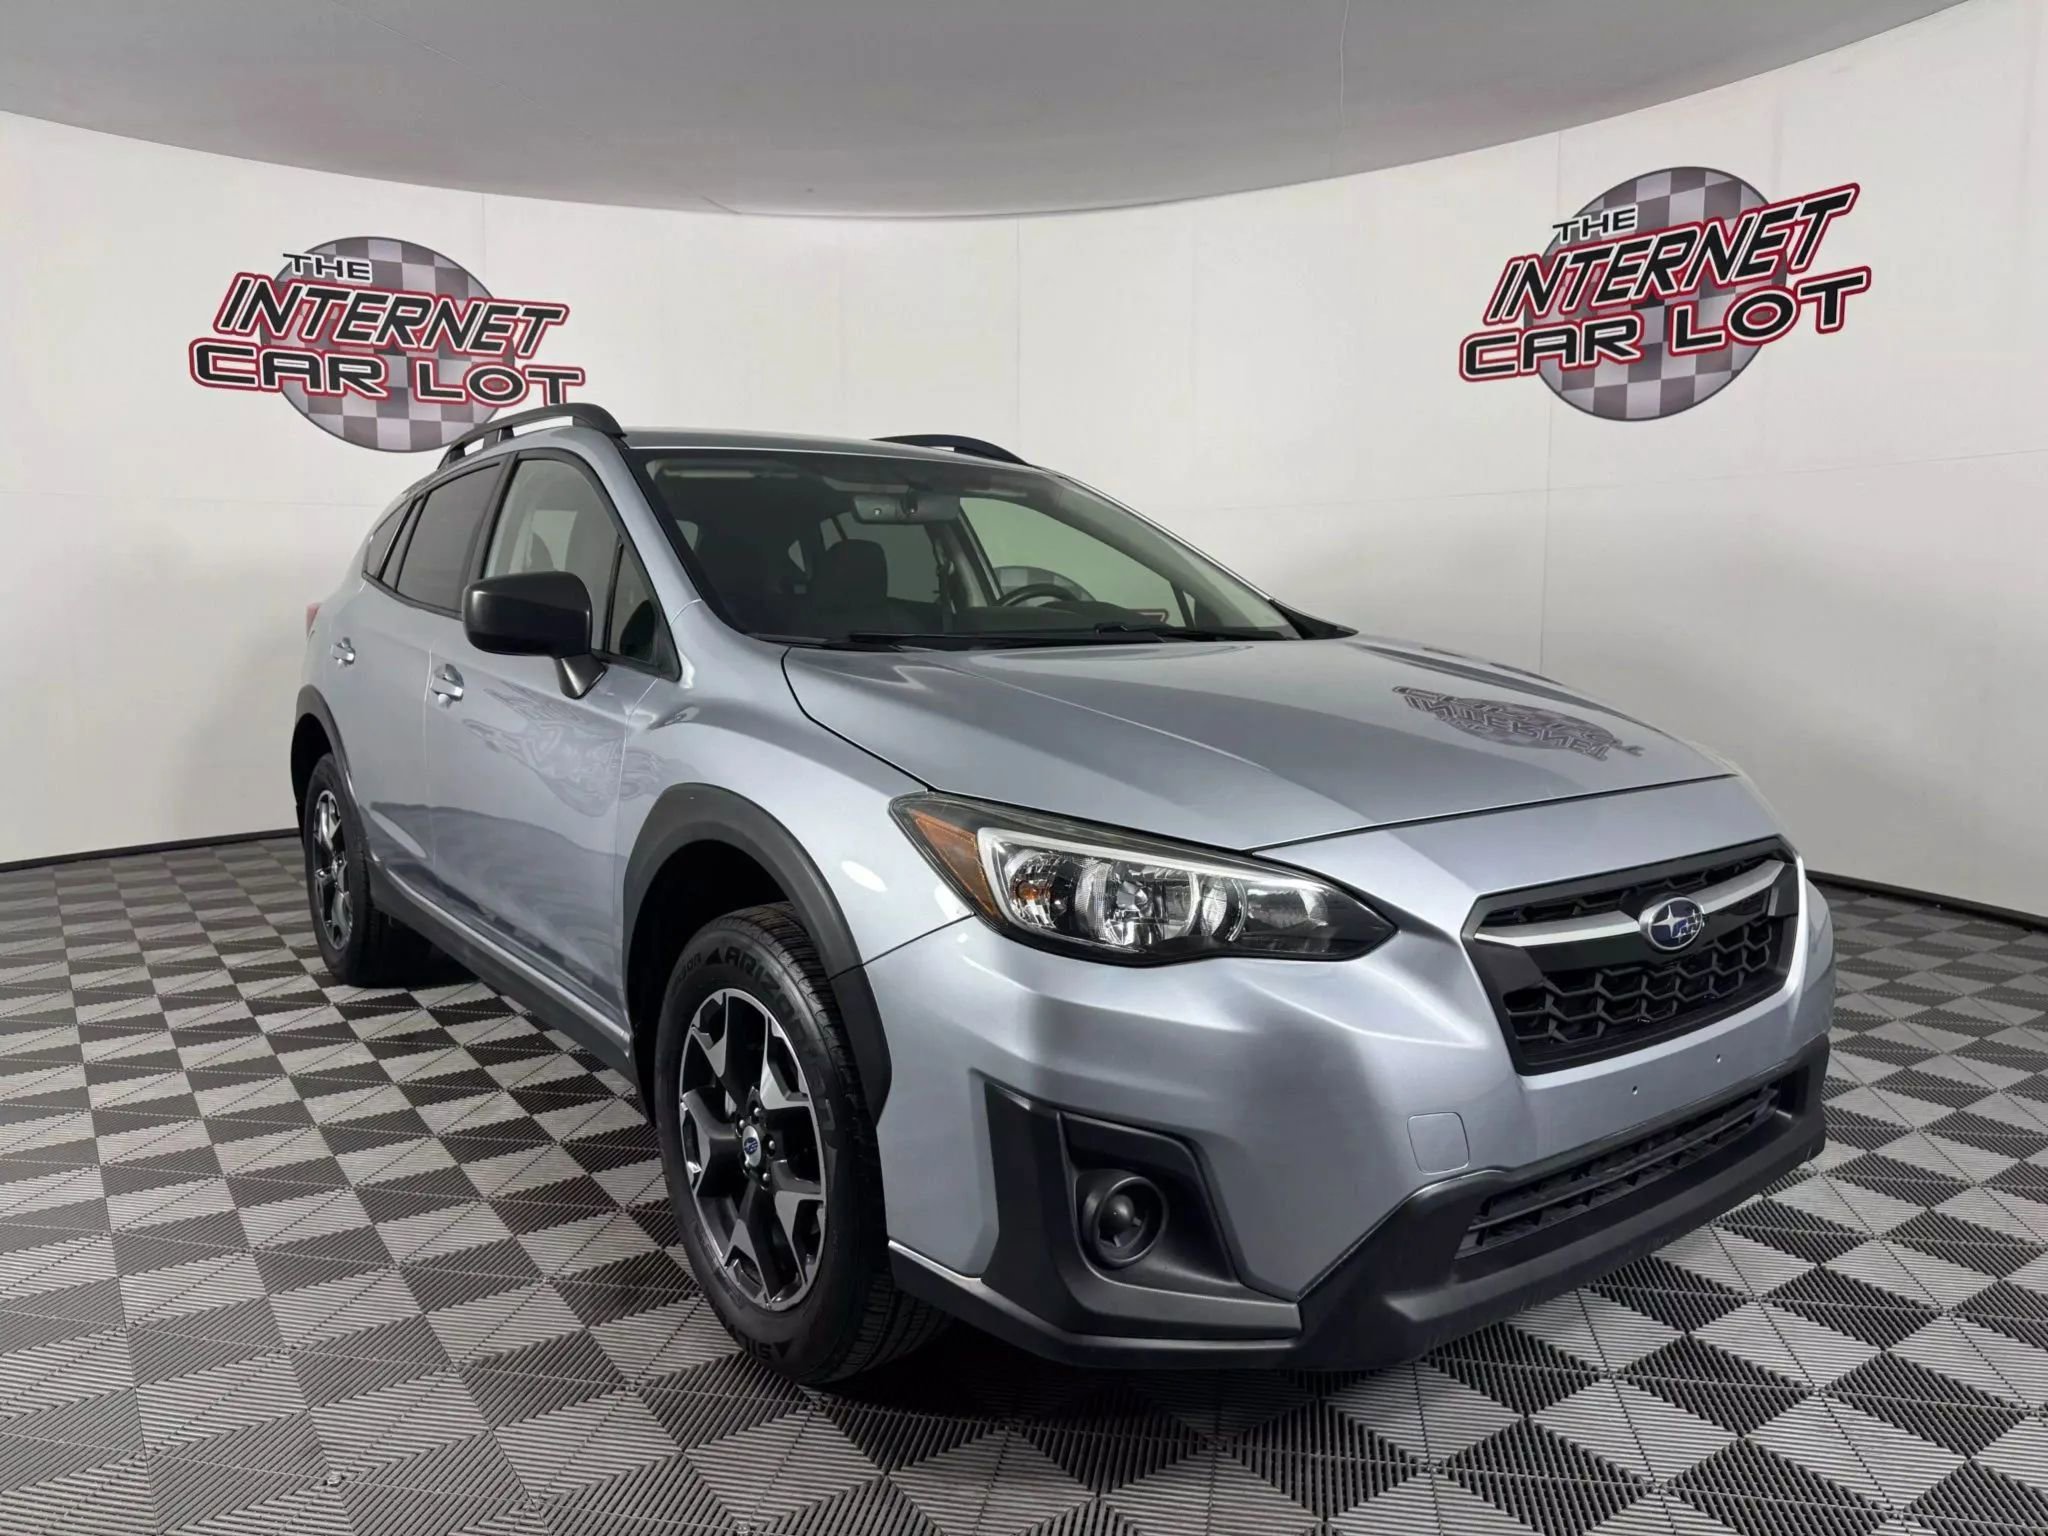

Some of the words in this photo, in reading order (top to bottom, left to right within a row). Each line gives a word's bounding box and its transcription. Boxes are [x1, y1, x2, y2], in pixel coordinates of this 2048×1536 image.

[1485, 185, 1859, 324] INTERNET
[1552, 205, 1638, 244] THE
[283, 253, 371, 281] THE
[216, 275, 567, 357] INTERNET
[1462, 313, 1643, 380] CAR
[1670, 268, 1869, 354] LOT
[192, 341, 388, 399] CAR
[415, 361, 584, 406] LOT
